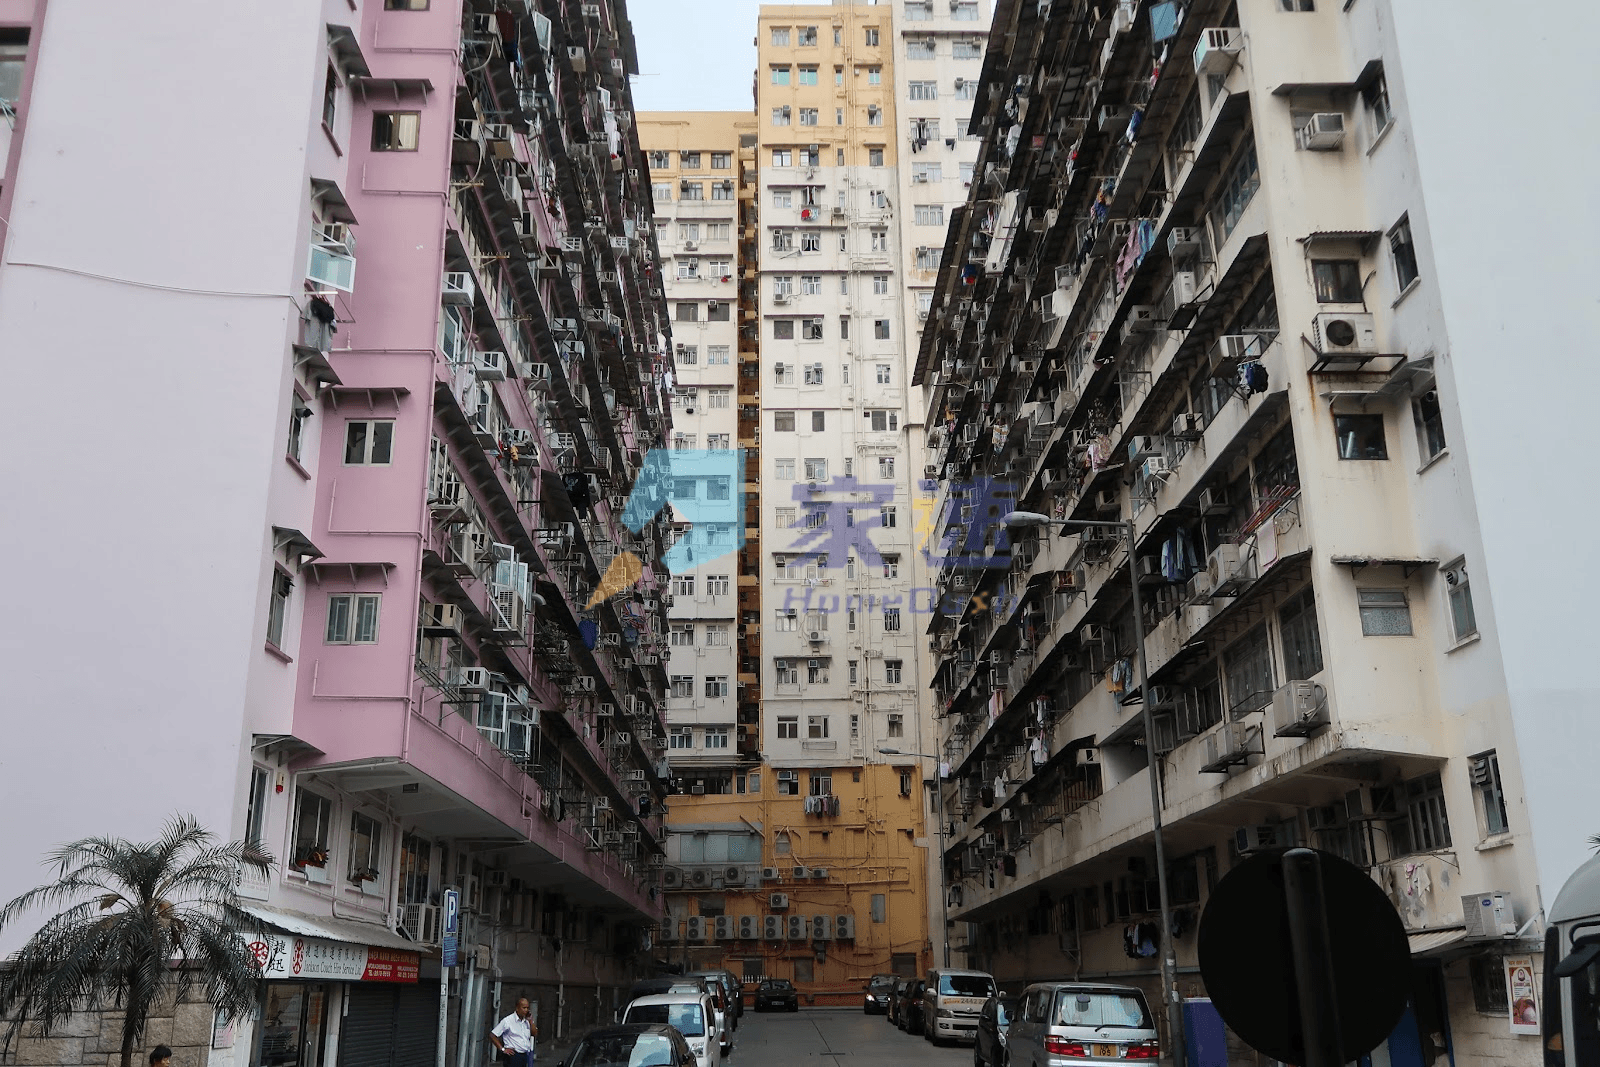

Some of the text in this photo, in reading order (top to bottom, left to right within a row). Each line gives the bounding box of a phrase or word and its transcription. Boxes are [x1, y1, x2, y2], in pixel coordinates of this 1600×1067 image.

[447, 895, 456, 929] P
[333, 962, 342, 974] Hire
[341, 963, 355, 975] Service
